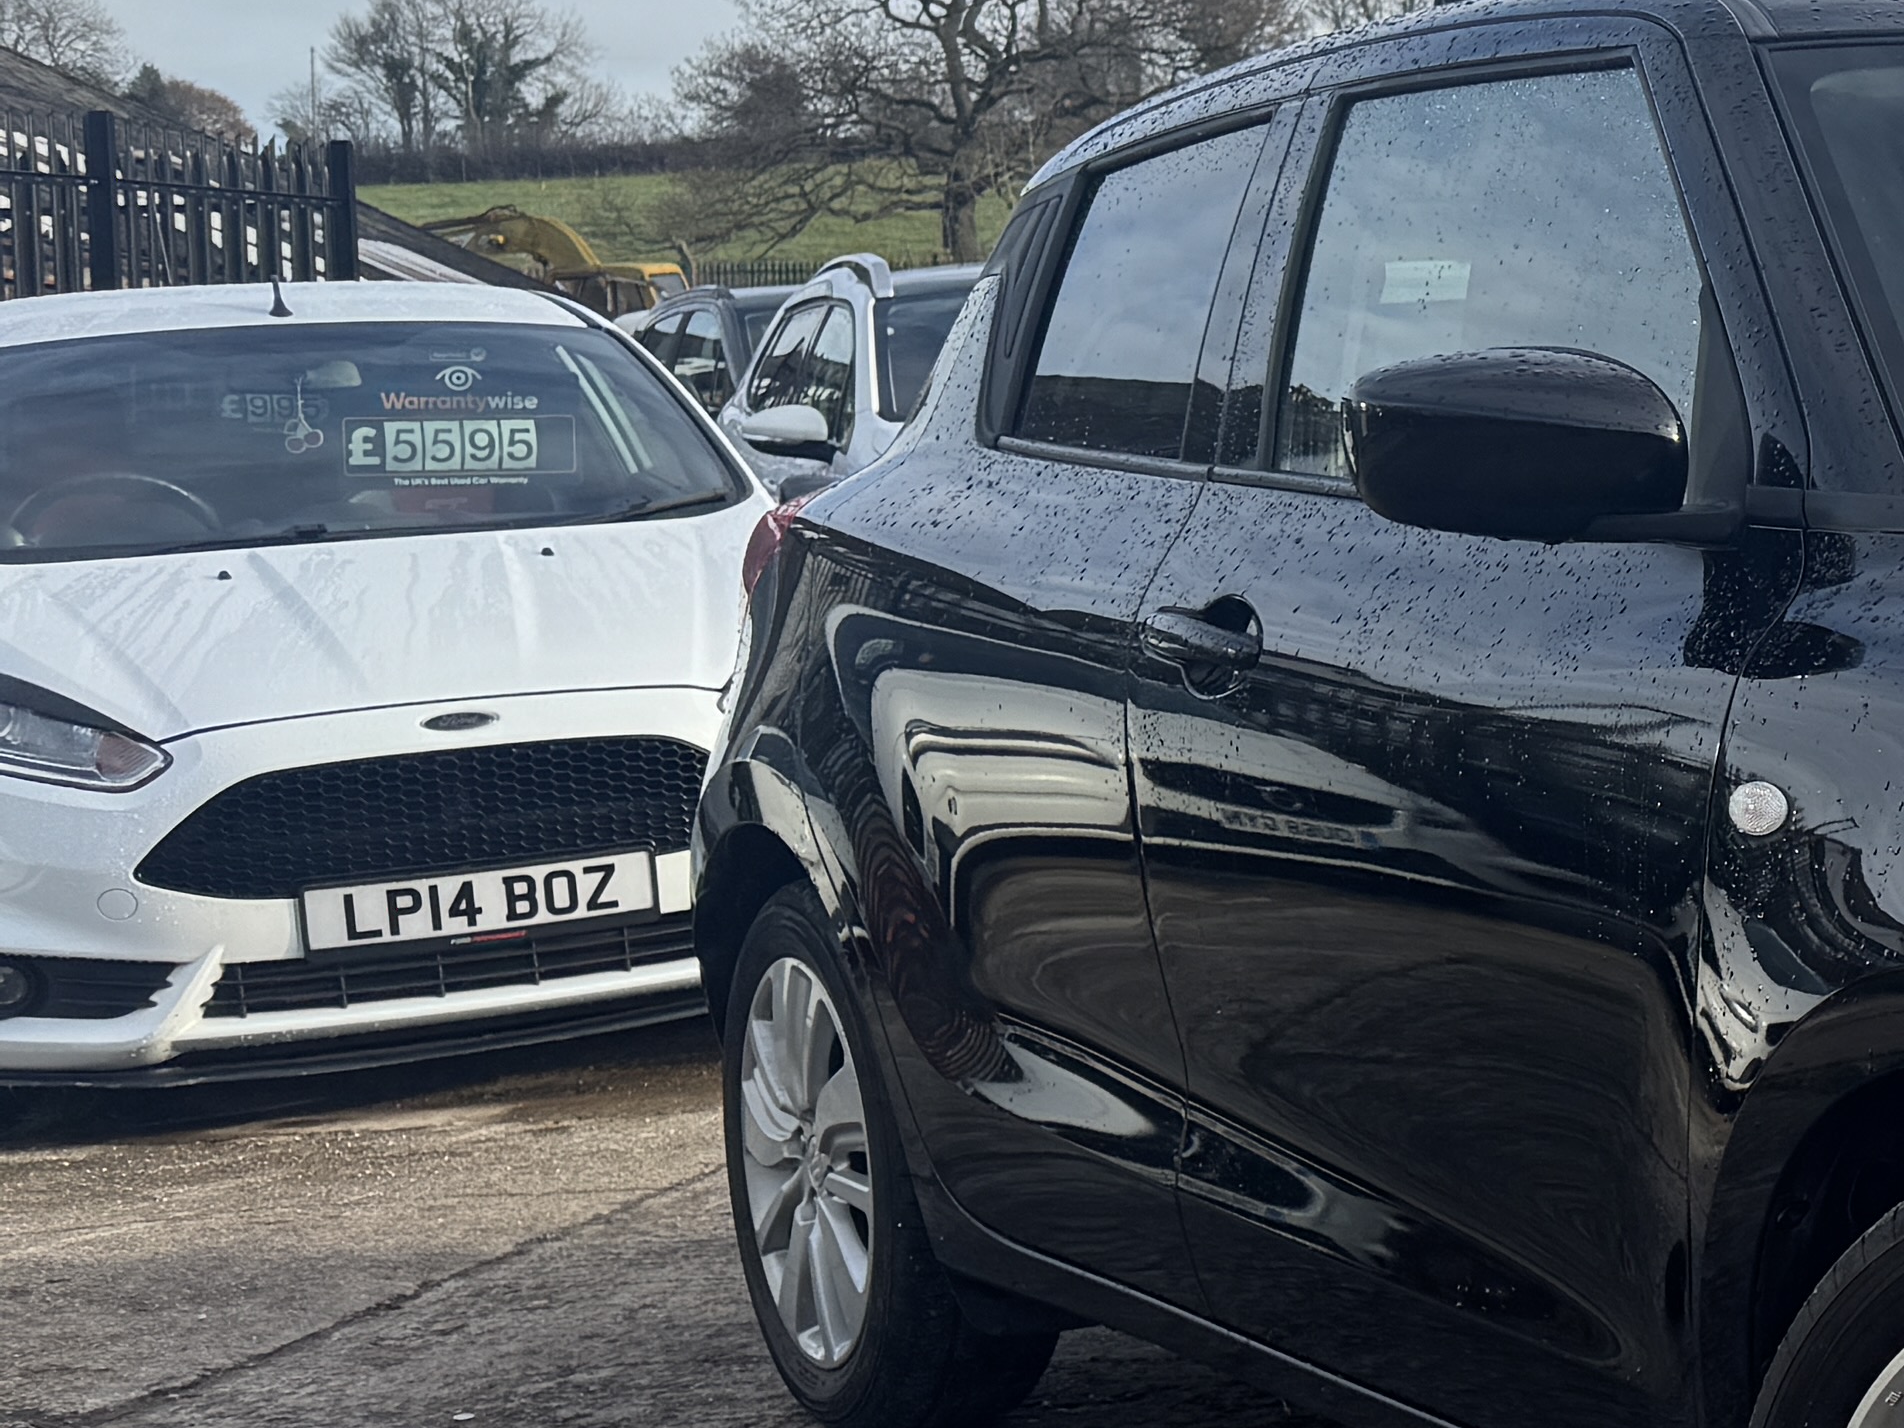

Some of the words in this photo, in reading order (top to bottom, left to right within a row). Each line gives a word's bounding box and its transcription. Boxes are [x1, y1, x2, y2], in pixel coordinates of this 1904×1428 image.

[380, 391, 539, 413] Warrantywise
[348, 426, 535, 466] £5595
[343, 880, 483, 941] LP14
[502, 863, 619, 922] BOZ
